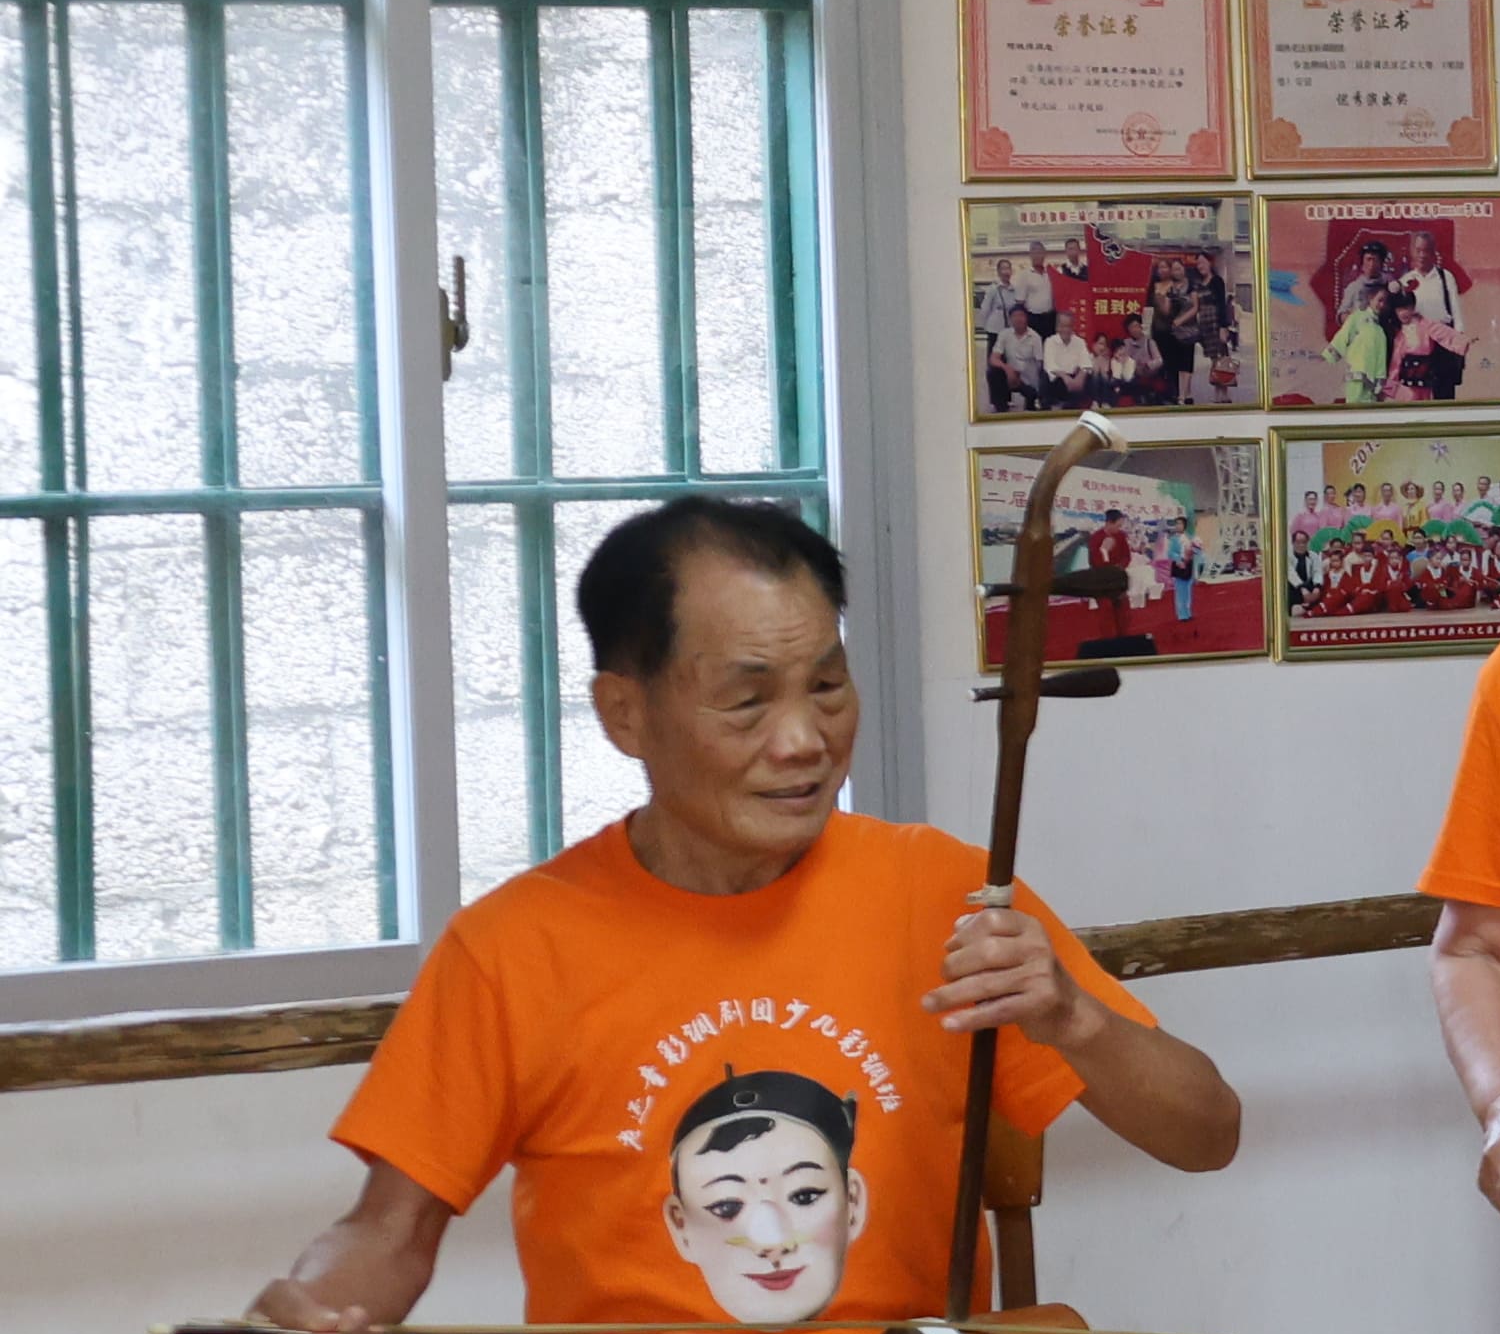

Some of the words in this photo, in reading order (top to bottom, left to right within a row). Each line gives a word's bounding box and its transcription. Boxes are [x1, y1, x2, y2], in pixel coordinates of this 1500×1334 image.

[1053, 12, 1139, 37] 荣誉证书
[1327, 8, 1411, 33] 荣誉证书
[1094, 298, 1142, 316] 报到处
